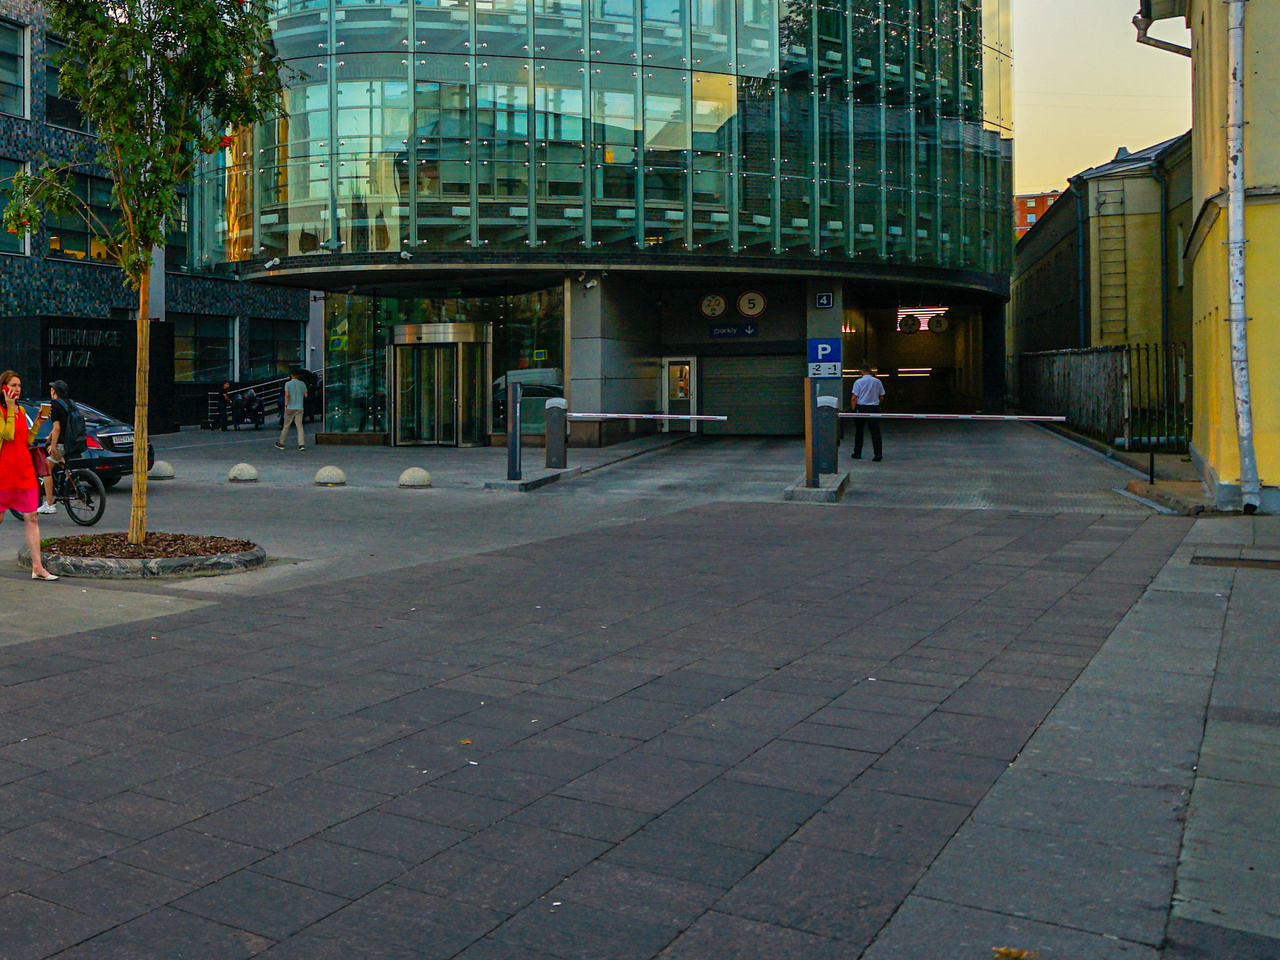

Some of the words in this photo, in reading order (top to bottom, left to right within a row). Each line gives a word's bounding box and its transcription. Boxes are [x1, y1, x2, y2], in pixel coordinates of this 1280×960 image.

[747, 298, 756, 309] 5
[820, 296, 828, 304] 4
[48, 328, 122, 347] HERMITAGE
[48, 350, 95, 367] PLAZA
[817, 344, 832, 360] P
[812, 364, 821, 372] -2
[828, 364, 837, 372] -1
